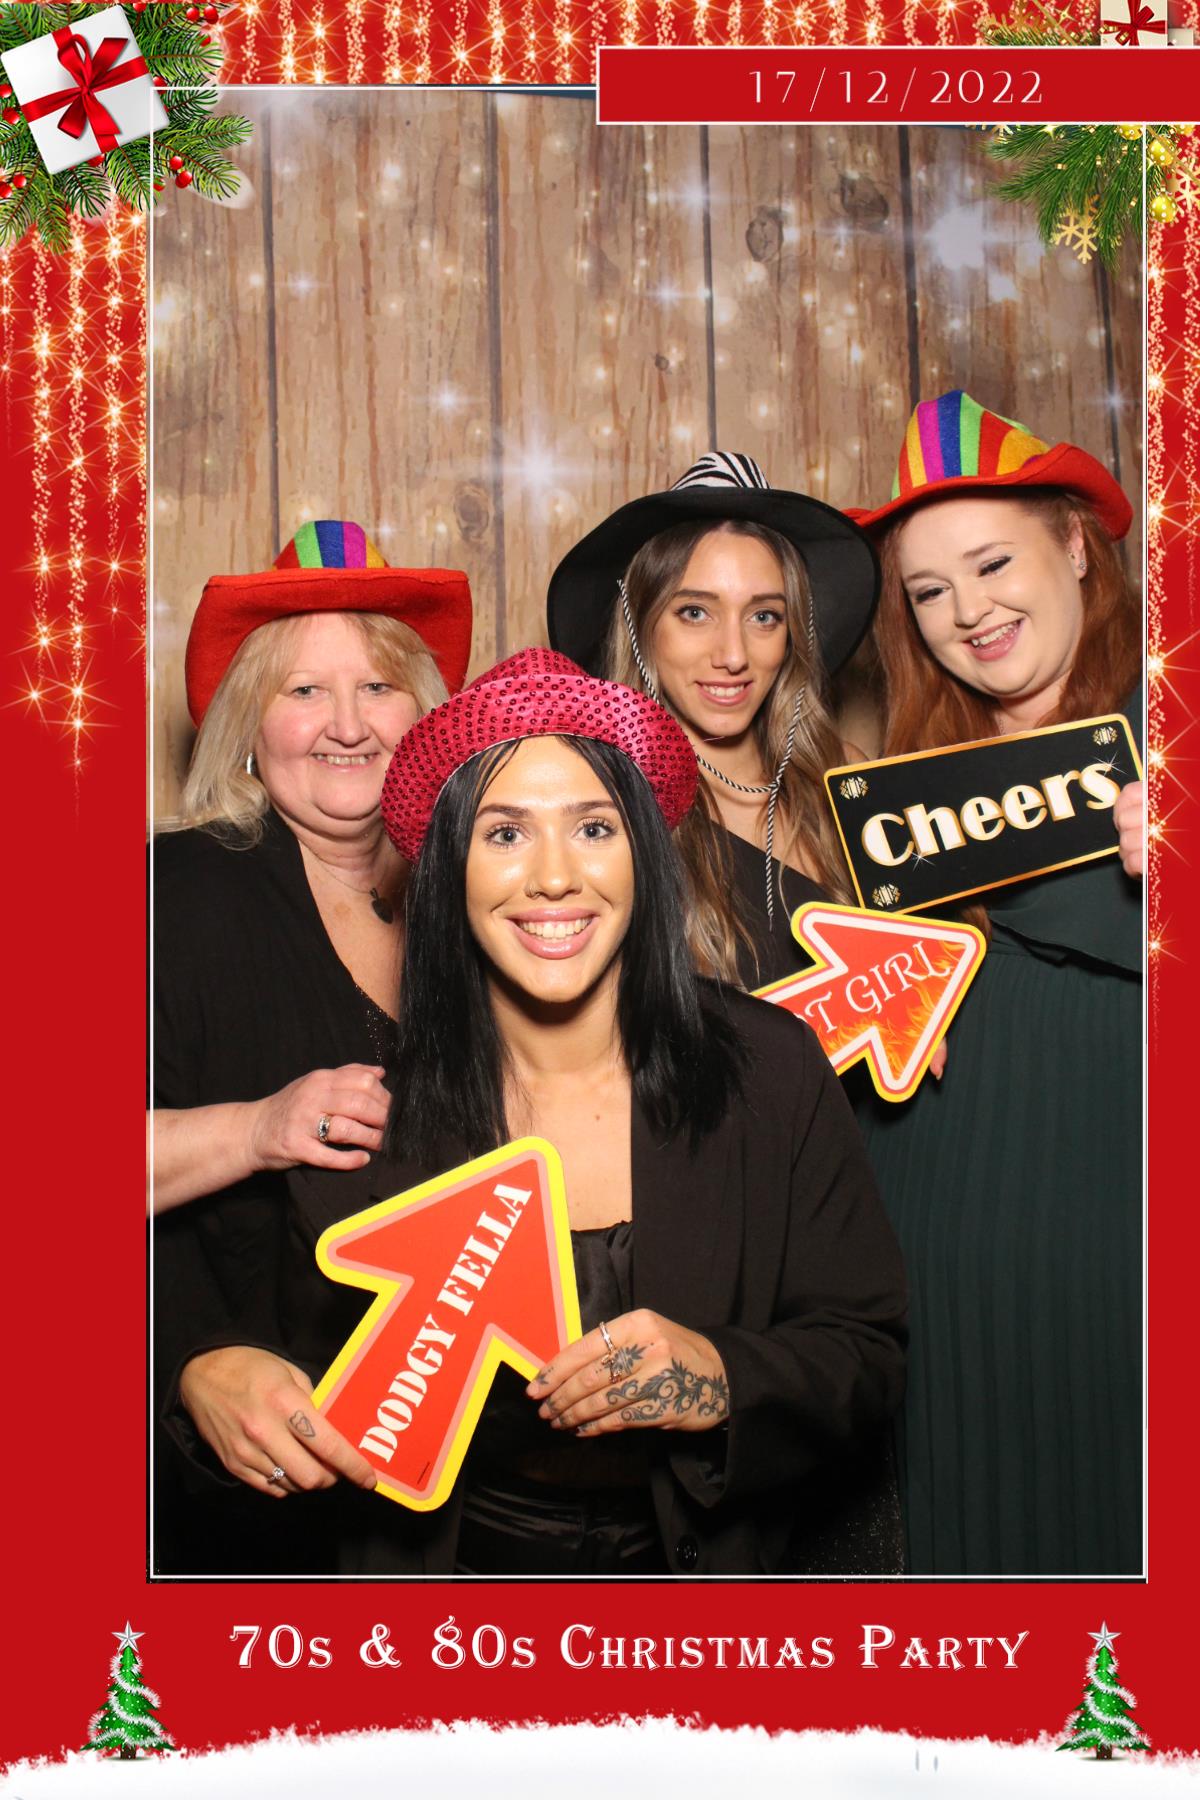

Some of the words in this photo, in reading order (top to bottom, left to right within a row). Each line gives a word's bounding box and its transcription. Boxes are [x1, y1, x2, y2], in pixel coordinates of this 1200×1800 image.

[861, 762, 1121, 866] Cheers
[793, 990, 838, 1034] T
[845, 941, 955, 1015] GIRL
[358, 1313, 456, 1464] DODGY
[437, 1183, 533, 1317] FELLA
